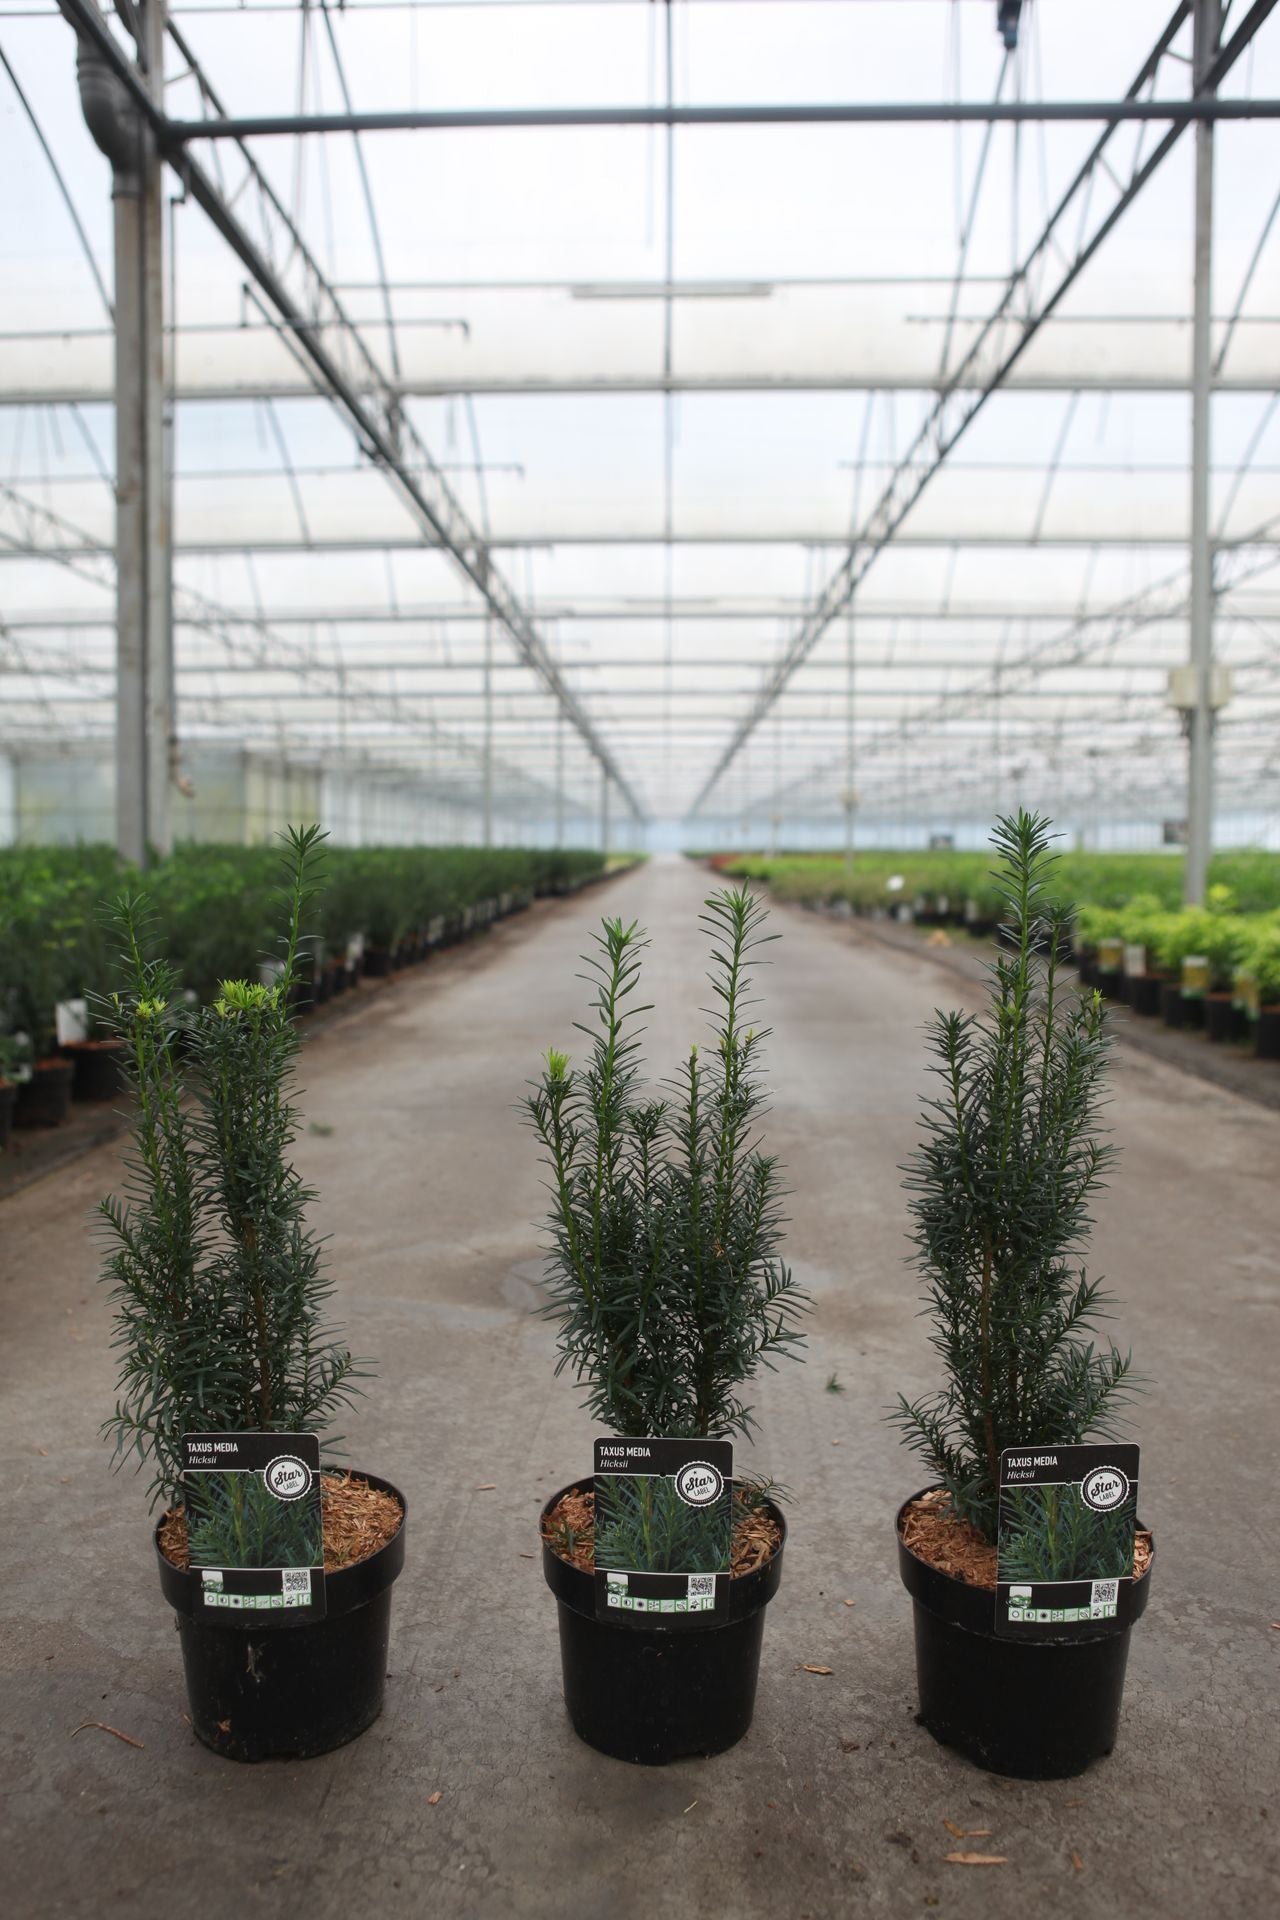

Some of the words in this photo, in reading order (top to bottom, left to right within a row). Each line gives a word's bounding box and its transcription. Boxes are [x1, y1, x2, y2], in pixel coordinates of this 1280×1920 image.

[187, 1442, 212, 1453] TAXUS
[214, 1442, 239, 1453] MEDIA
[599, 1446, 625, 1457] TAXUS
[626, 1446, 651, 1457] MEDIA
[188, 1455, 218, 1465] Hicksii
[600, 1459, 629, 1469] Hicksii
[1007, 1457, 1032, 1468] TAXUS
[1033, 1456, 1059, 1467] MEDIA
[274, 1469, 303, 1487] Star
[1007, 1470, 1036, 1480] Hicksii
[282, 1480, 300, 1491] LABEL
[685, 1475, 715, 1493] Star
[1090, 1479, 1120, 1499] Star
[693, 1487, 711, 1497] LABEL
[1099, 1491, 1116, 1502] LABEL
